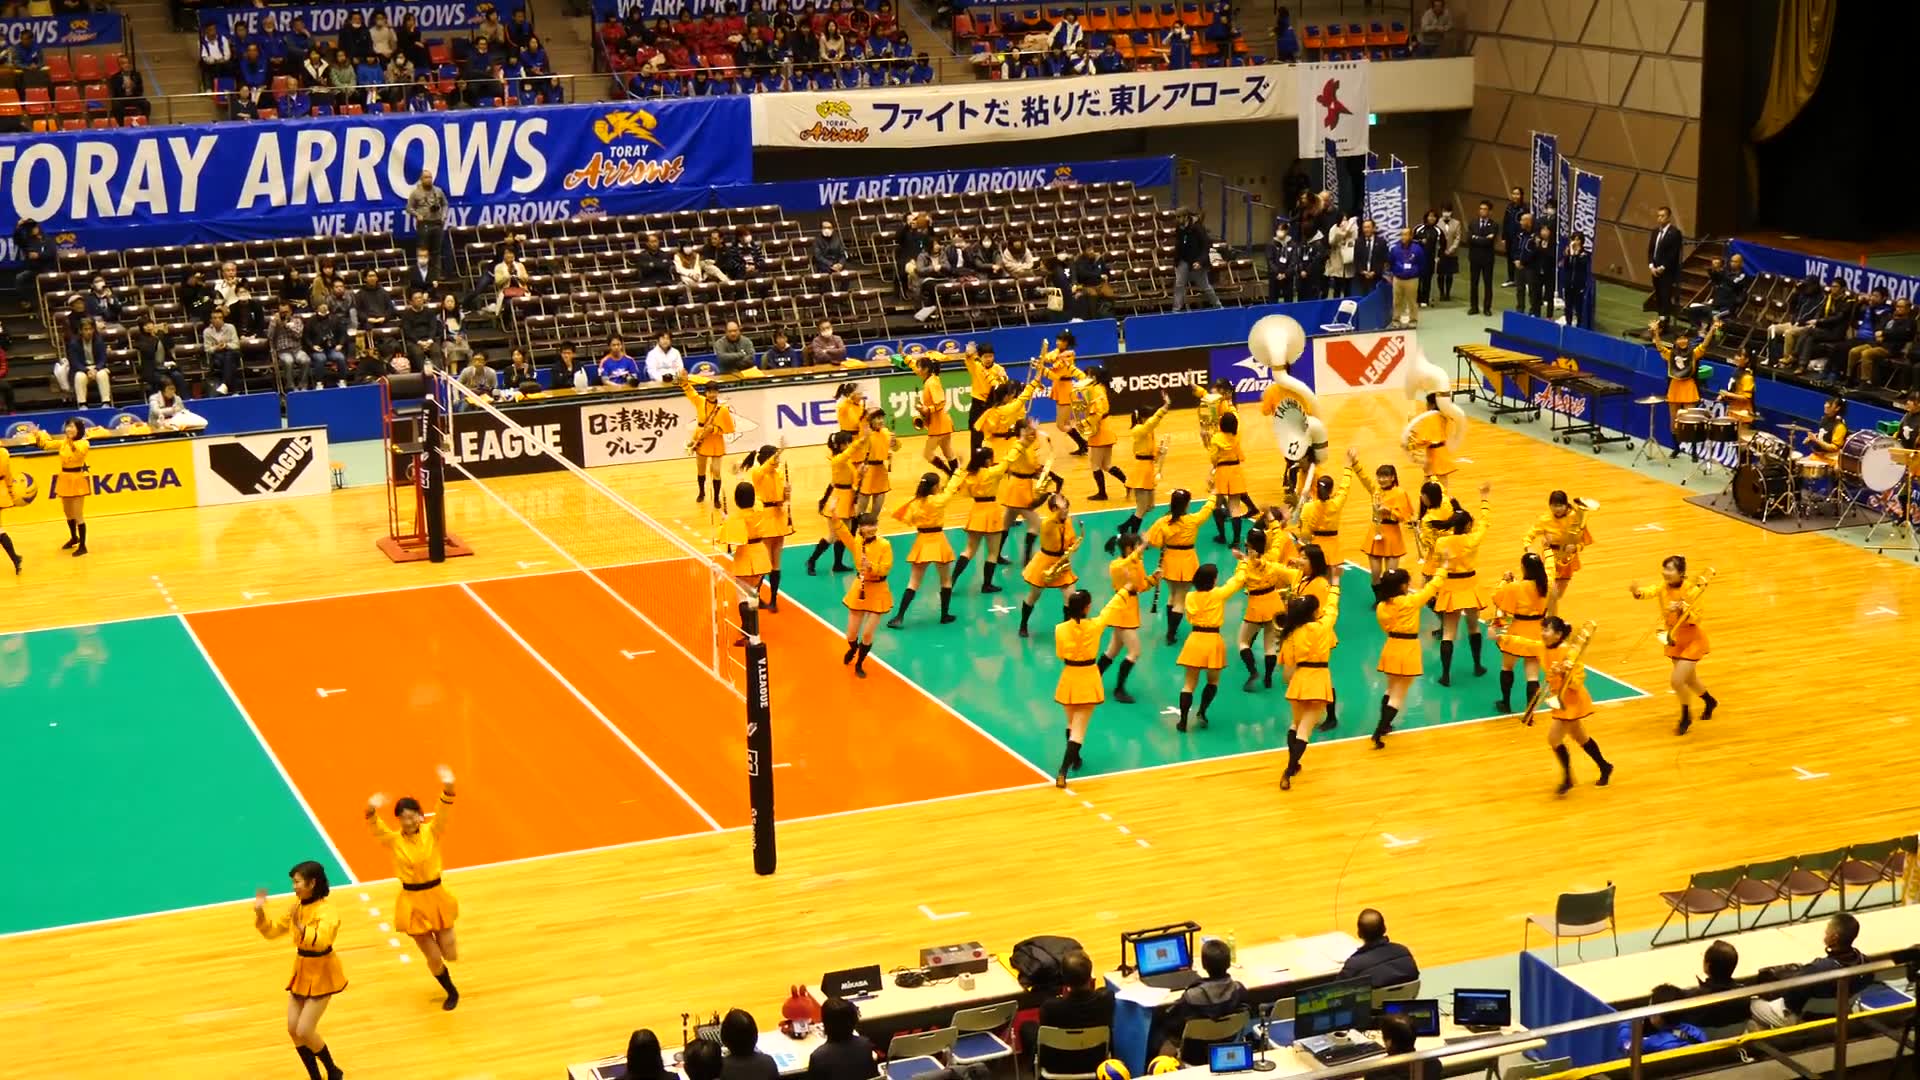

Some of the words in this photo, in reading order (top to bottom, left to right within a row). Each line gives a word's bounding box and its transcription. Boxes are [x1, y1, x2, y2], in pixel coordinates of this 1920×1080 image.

[310, 7, 375, 31] TORY
[236, 117, 547, 209] ARROWS
[610, 144, 649, 158] TORAY
[563, 151, 685, 190] Arrows
[818, 183, 848, 206] WE
[854, 181, 892, 201] ARE
[898, 173, 960, 197] TORAY
[964, 168, 1047, 193] ARROWS
[312, 213, 346, 237] WE
[350, 211, 394, 235] ARE
[403, 205, 472, 233] TAY
[478, 200, 570, 226] ARROWS
[1129, 369, 1208, 391] DESCENTE
[589, 407, 679, 435] 日清製粉
[777, 399, 839, 430] NE
[446, 423, 562, 464] LEAGUE
[605, 430, 664, 457] グループ
[254, 435, 312, 494] LEAGUE
[49, 467, 182, 499] KASA
[841, 980, 868, 990] MIKASA
